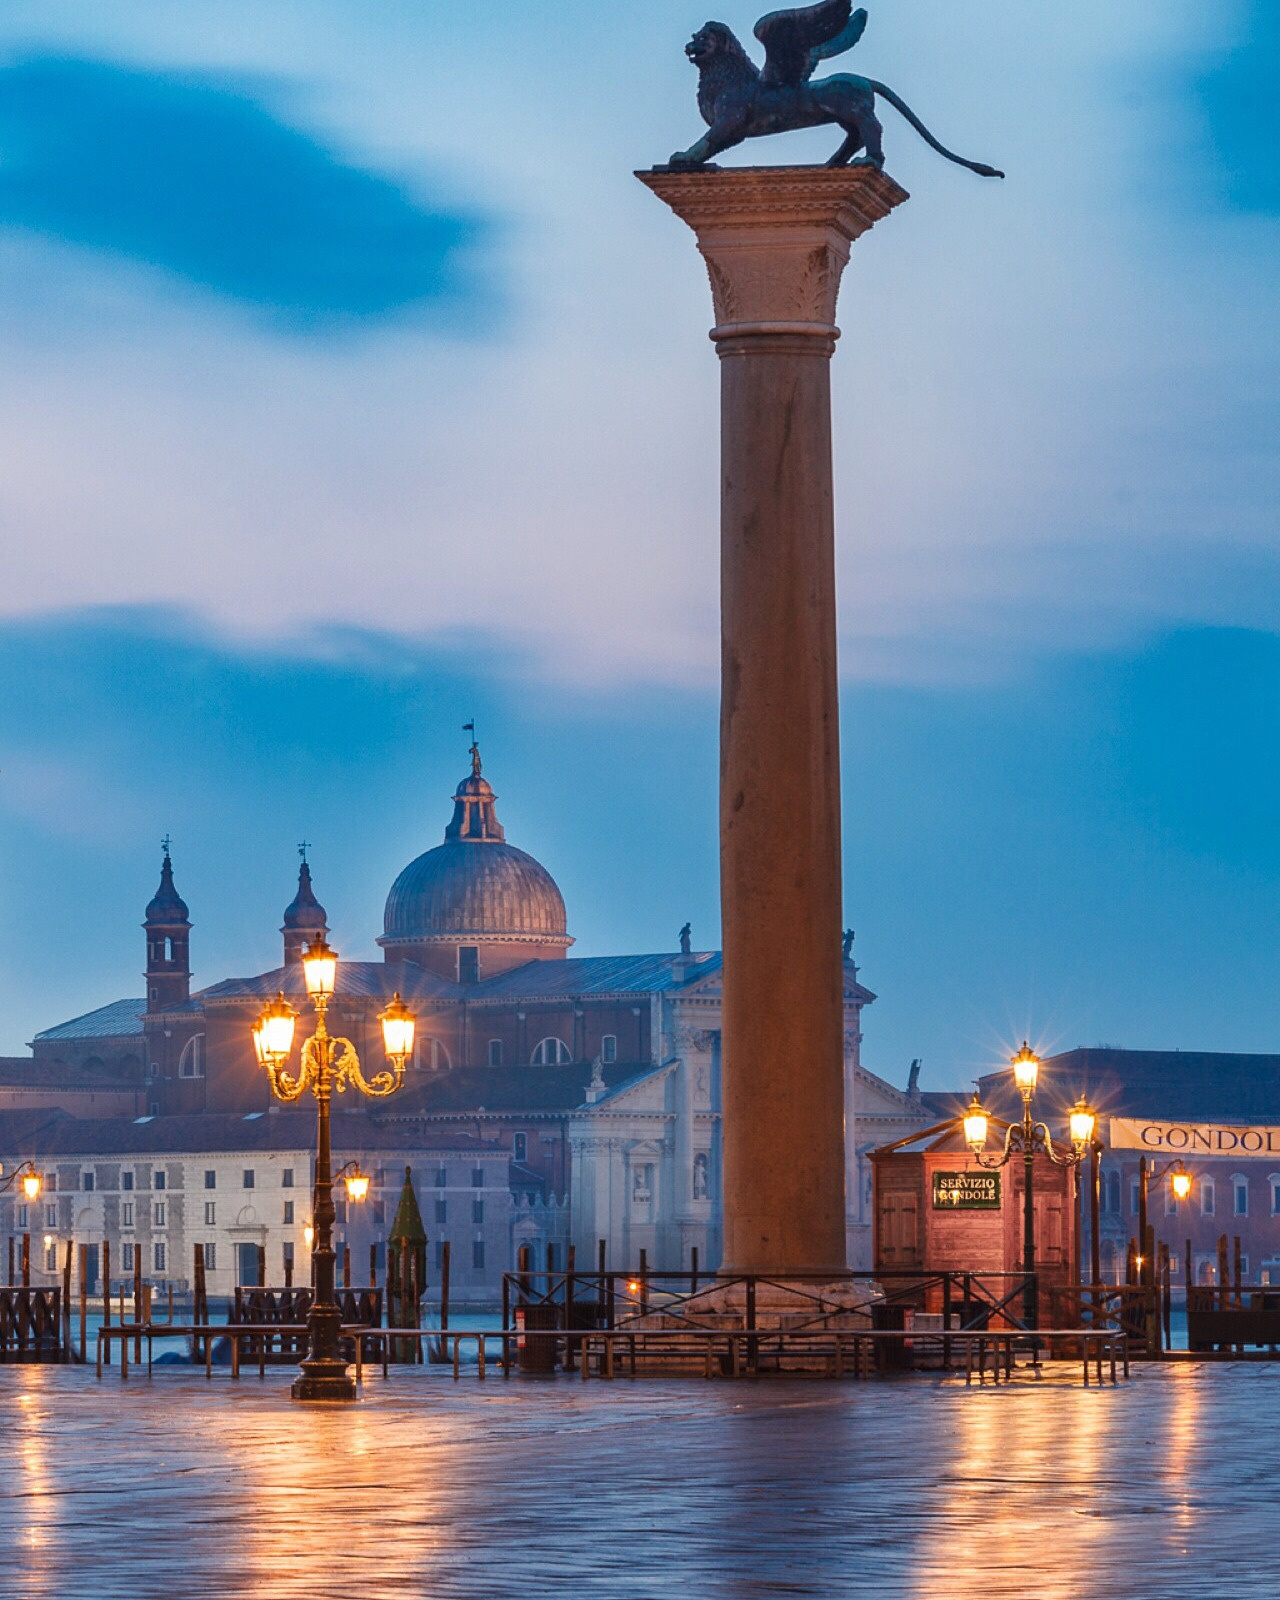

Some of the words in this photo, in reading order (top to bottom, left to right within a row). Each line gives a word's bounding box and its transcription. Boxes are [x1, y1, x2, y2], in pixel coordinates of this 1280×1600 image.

[1141, 1126, 1280, 1151] GONDOL
[940, 1179, 995, 1189] SERVIZIO
[939, 1190, 995, 1200] GONDOLE
